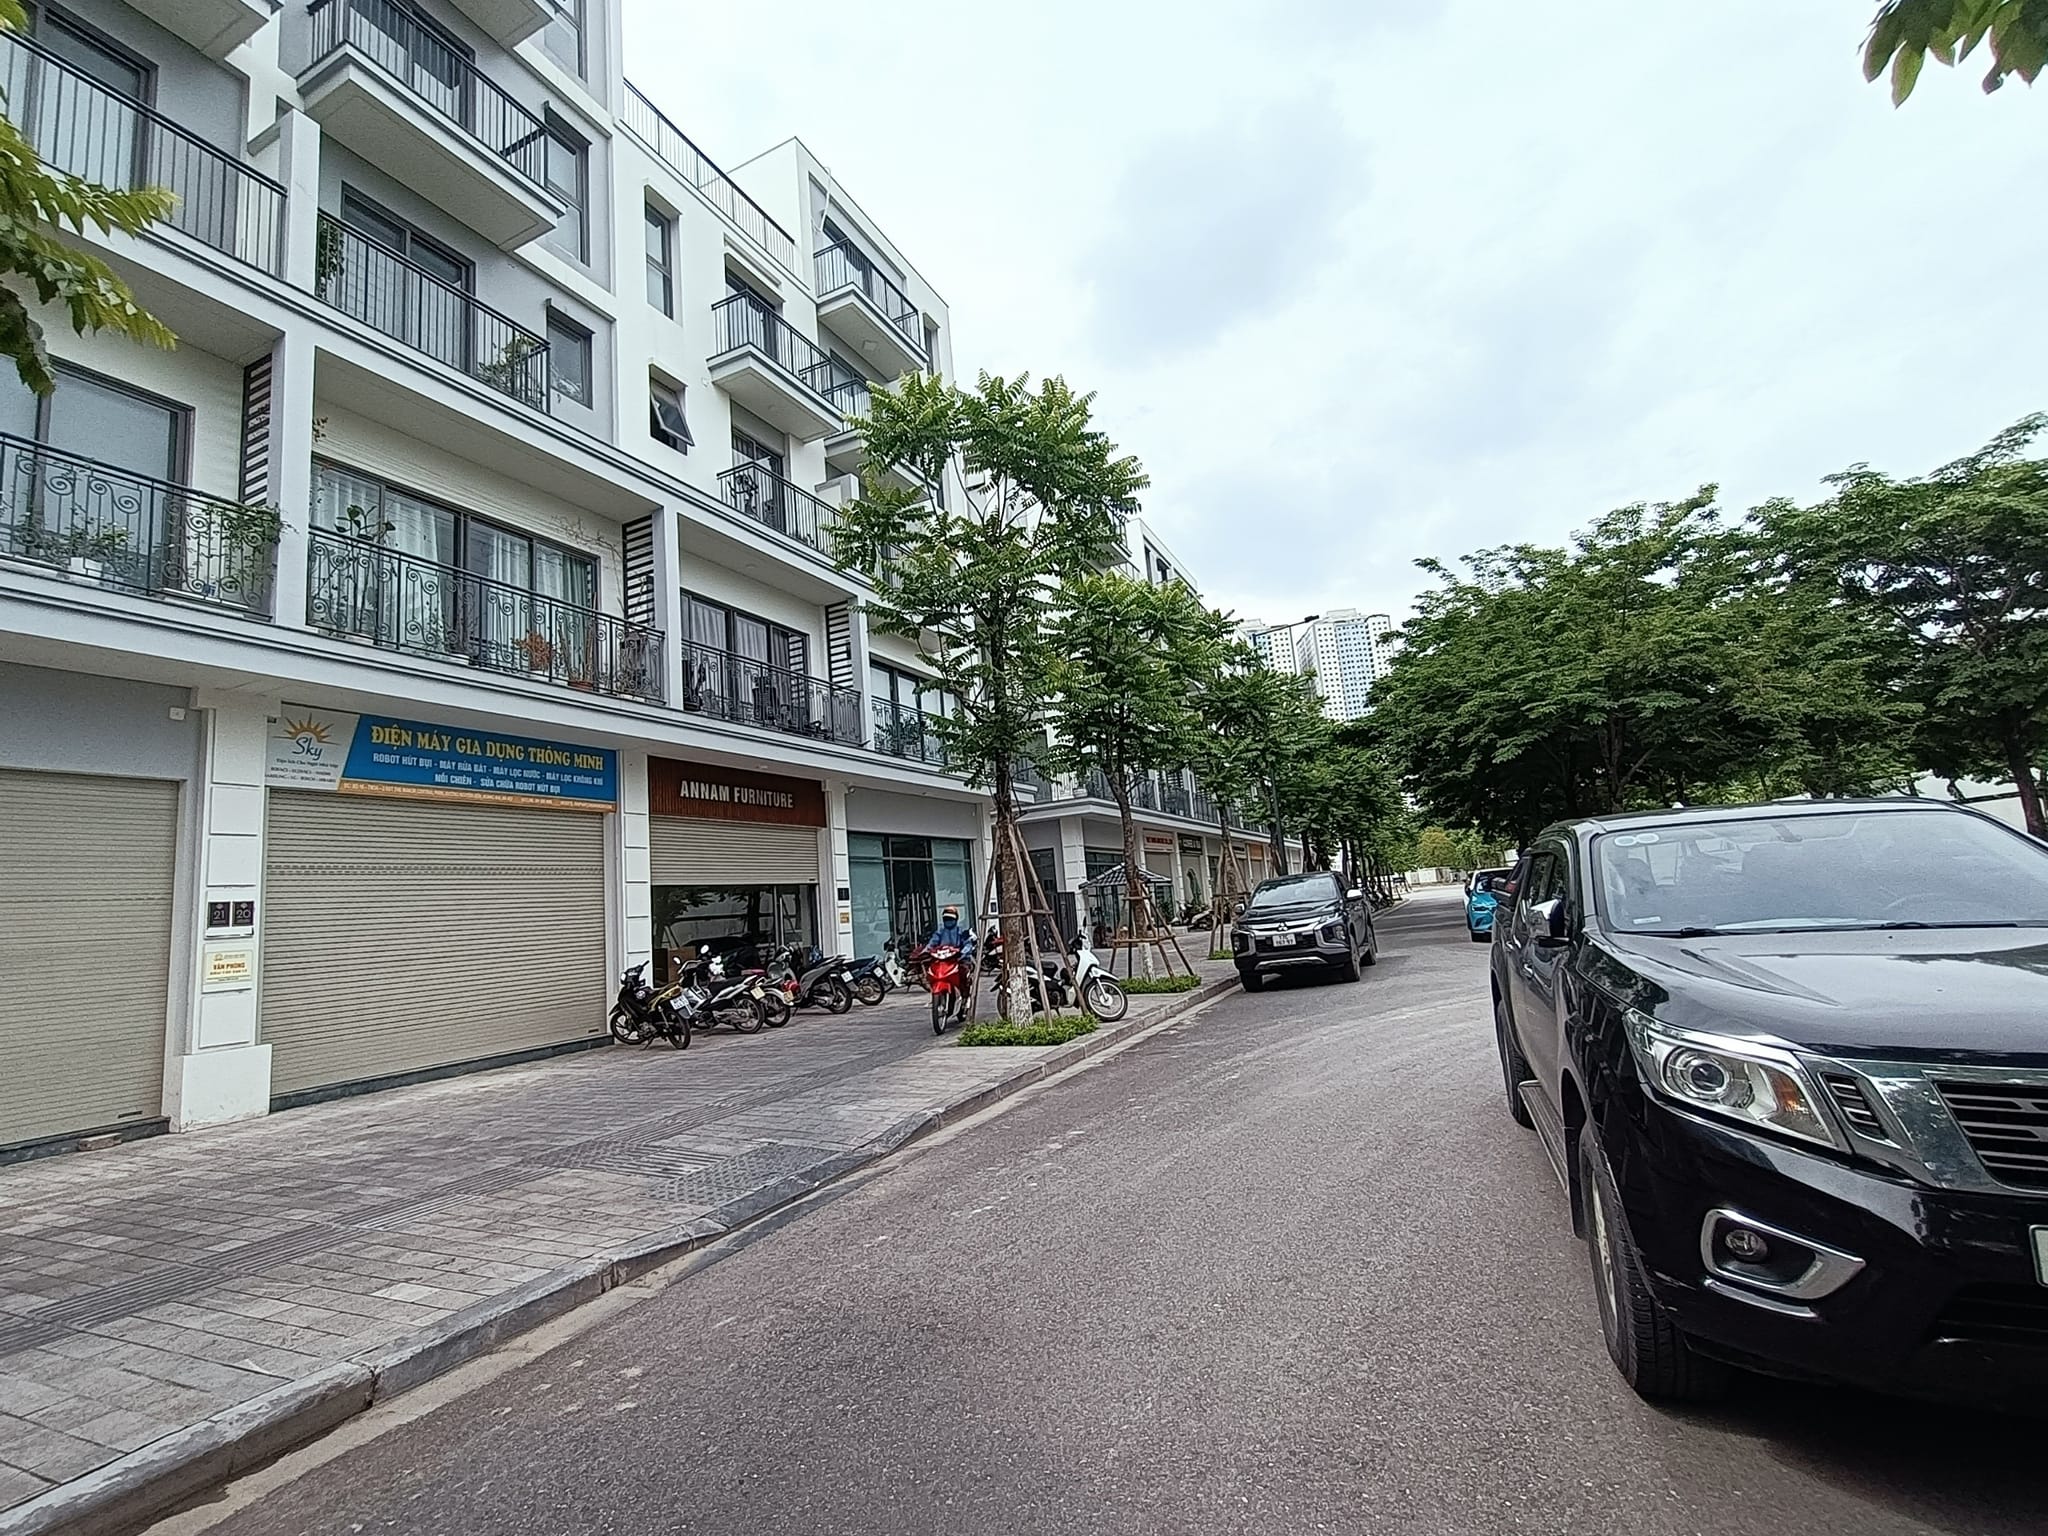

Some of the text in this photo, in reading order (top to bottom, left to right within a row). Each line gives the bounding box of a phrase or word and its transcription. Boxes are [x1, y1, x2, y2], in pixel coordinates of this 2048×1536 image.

[292, 736, 323, 761] Sky
[371, 724, 604, 771] ĐIỆN MÁY GIA DỤNG THÔNG MINH
[373, 752, 400, 764] ROBOT
[402, 754, 418, 767] HÚT
[439, 759, 456, 771] MÁY
[492, 764, 508, 776] MÁY
[514, 781, 536, 792] ROBOT
[680, 780, 794, 808] ANNAM FURNITURE
[213, 910, 225, 920] 21
[236, 909, 251, 919] 20
